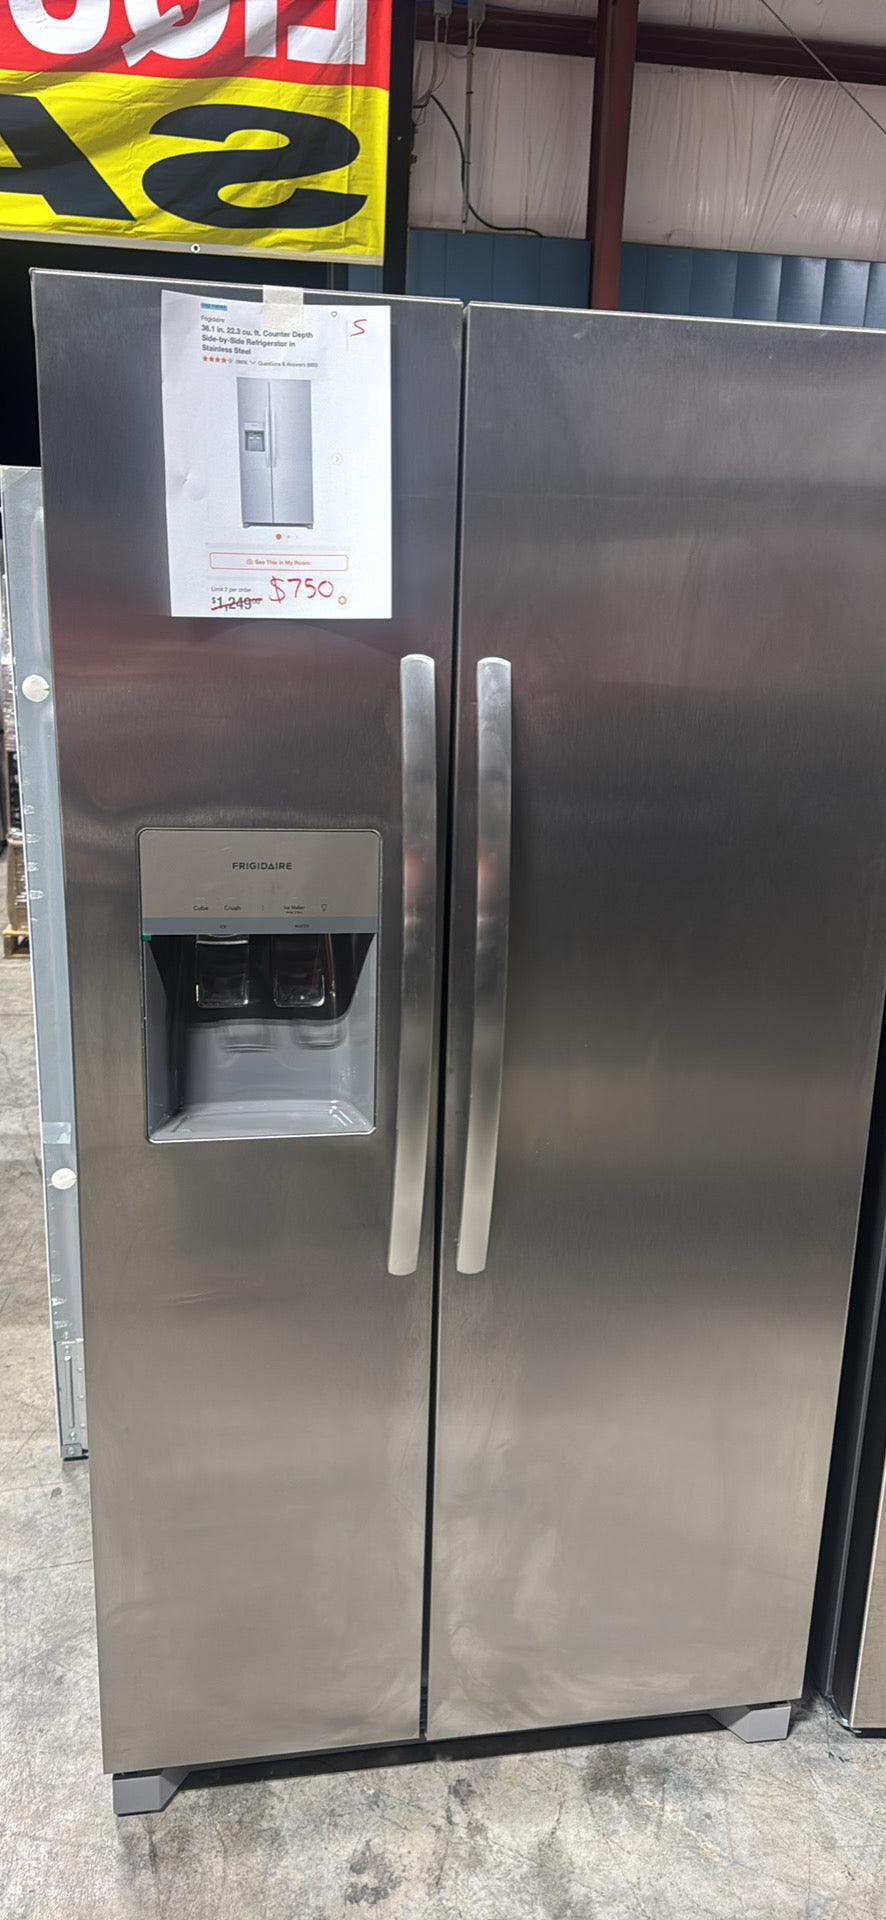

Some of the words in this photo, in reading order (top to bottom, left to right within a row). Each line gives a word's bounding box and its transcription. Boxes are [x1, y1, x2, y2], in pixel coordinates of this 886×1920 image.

[201, 324, 215, 333] 36.1
[226, 327, 241, 335] 22.3
[242, 329, 253, 337] cu.
[262, 329, 291, 338] Counter
[292, 330, 314, 340] Depth
[201, 334, 245, 345] Side-by-Side
[246, 338, 288, 348] Refrigerator
[201, 344, 233, 354] Stainless
[233, 347, 252, 356] Steel
[269, 575, 335, 604] $750
[231, 862, 293, 871] FRIGIDAIRE
[192, 904, 209, 912] Cube
[223, 904, 242, 912] Crush
